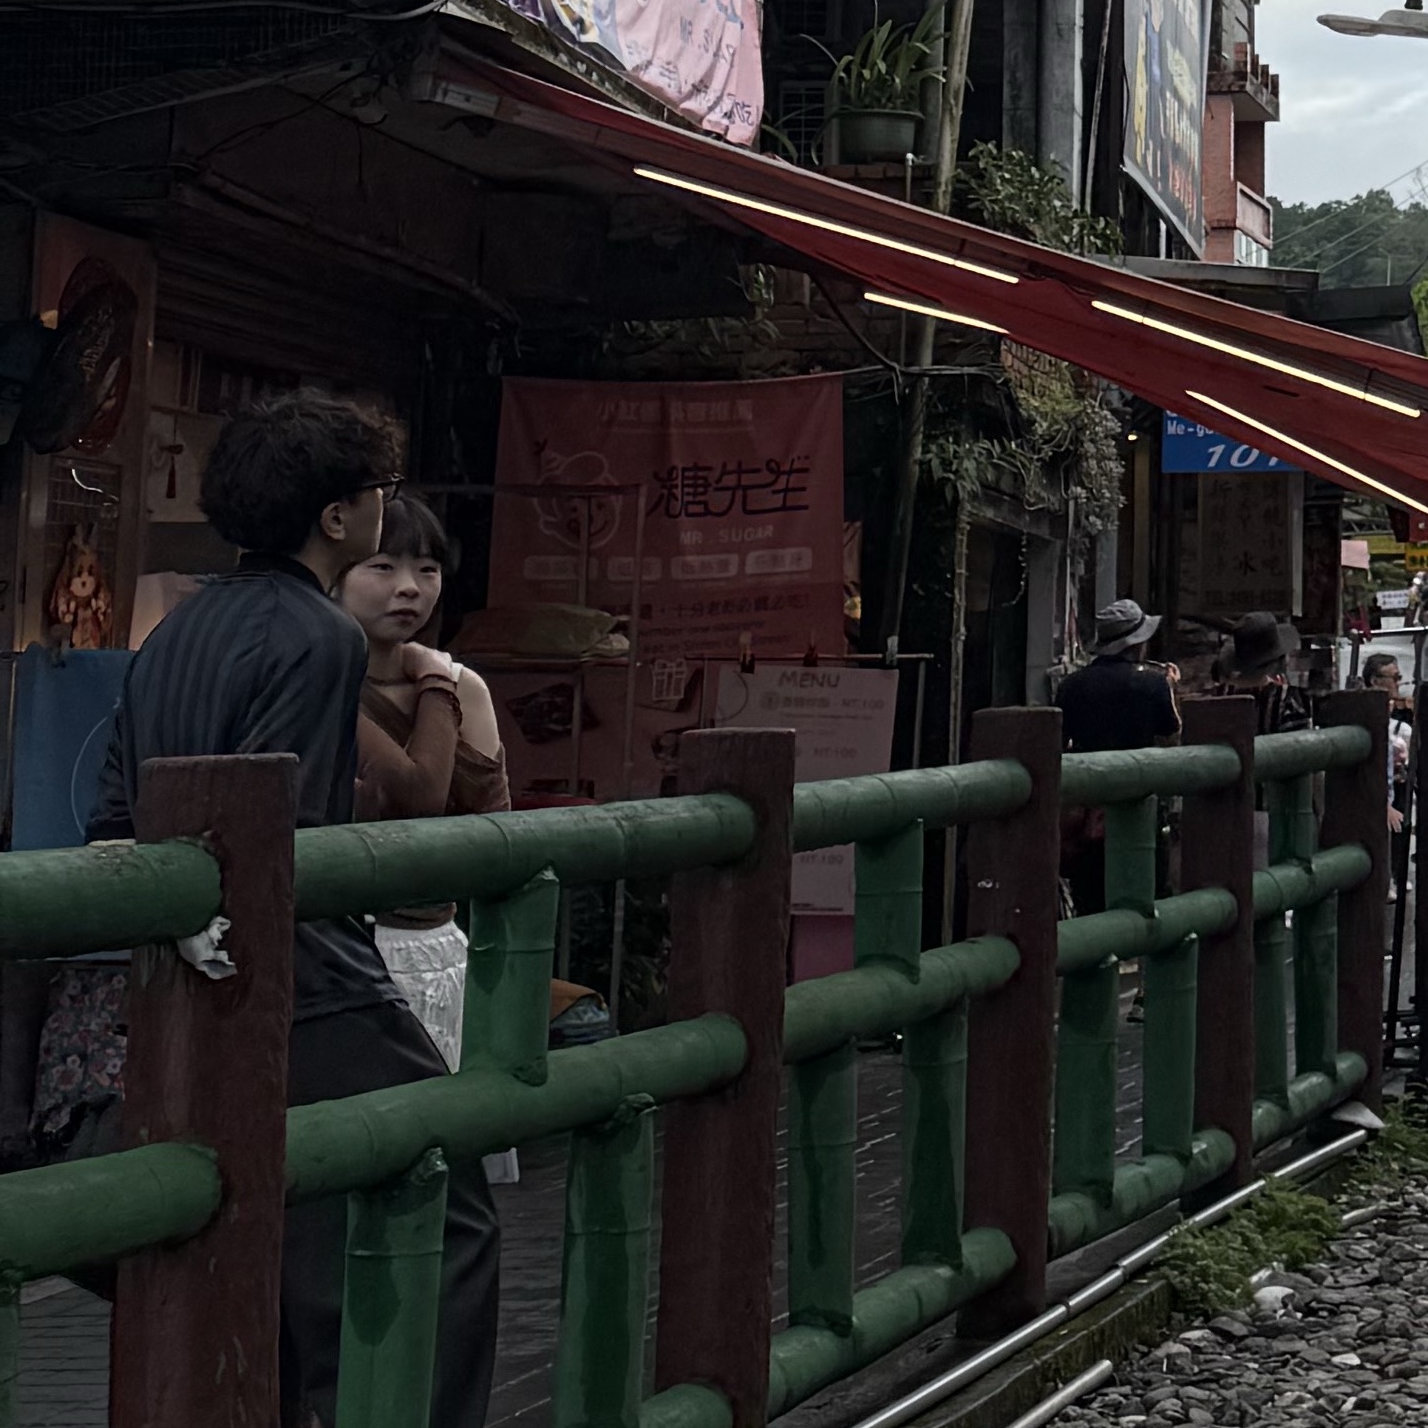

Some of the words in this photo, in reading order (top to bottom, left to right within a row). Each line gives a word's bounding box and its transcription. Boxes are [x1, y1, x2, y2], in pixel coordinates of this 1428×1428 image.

[646, 455, 811, 519] 糖先生
[719, 524, 775, 545] SUGAR
[778, 671, 842, 689] MENU
